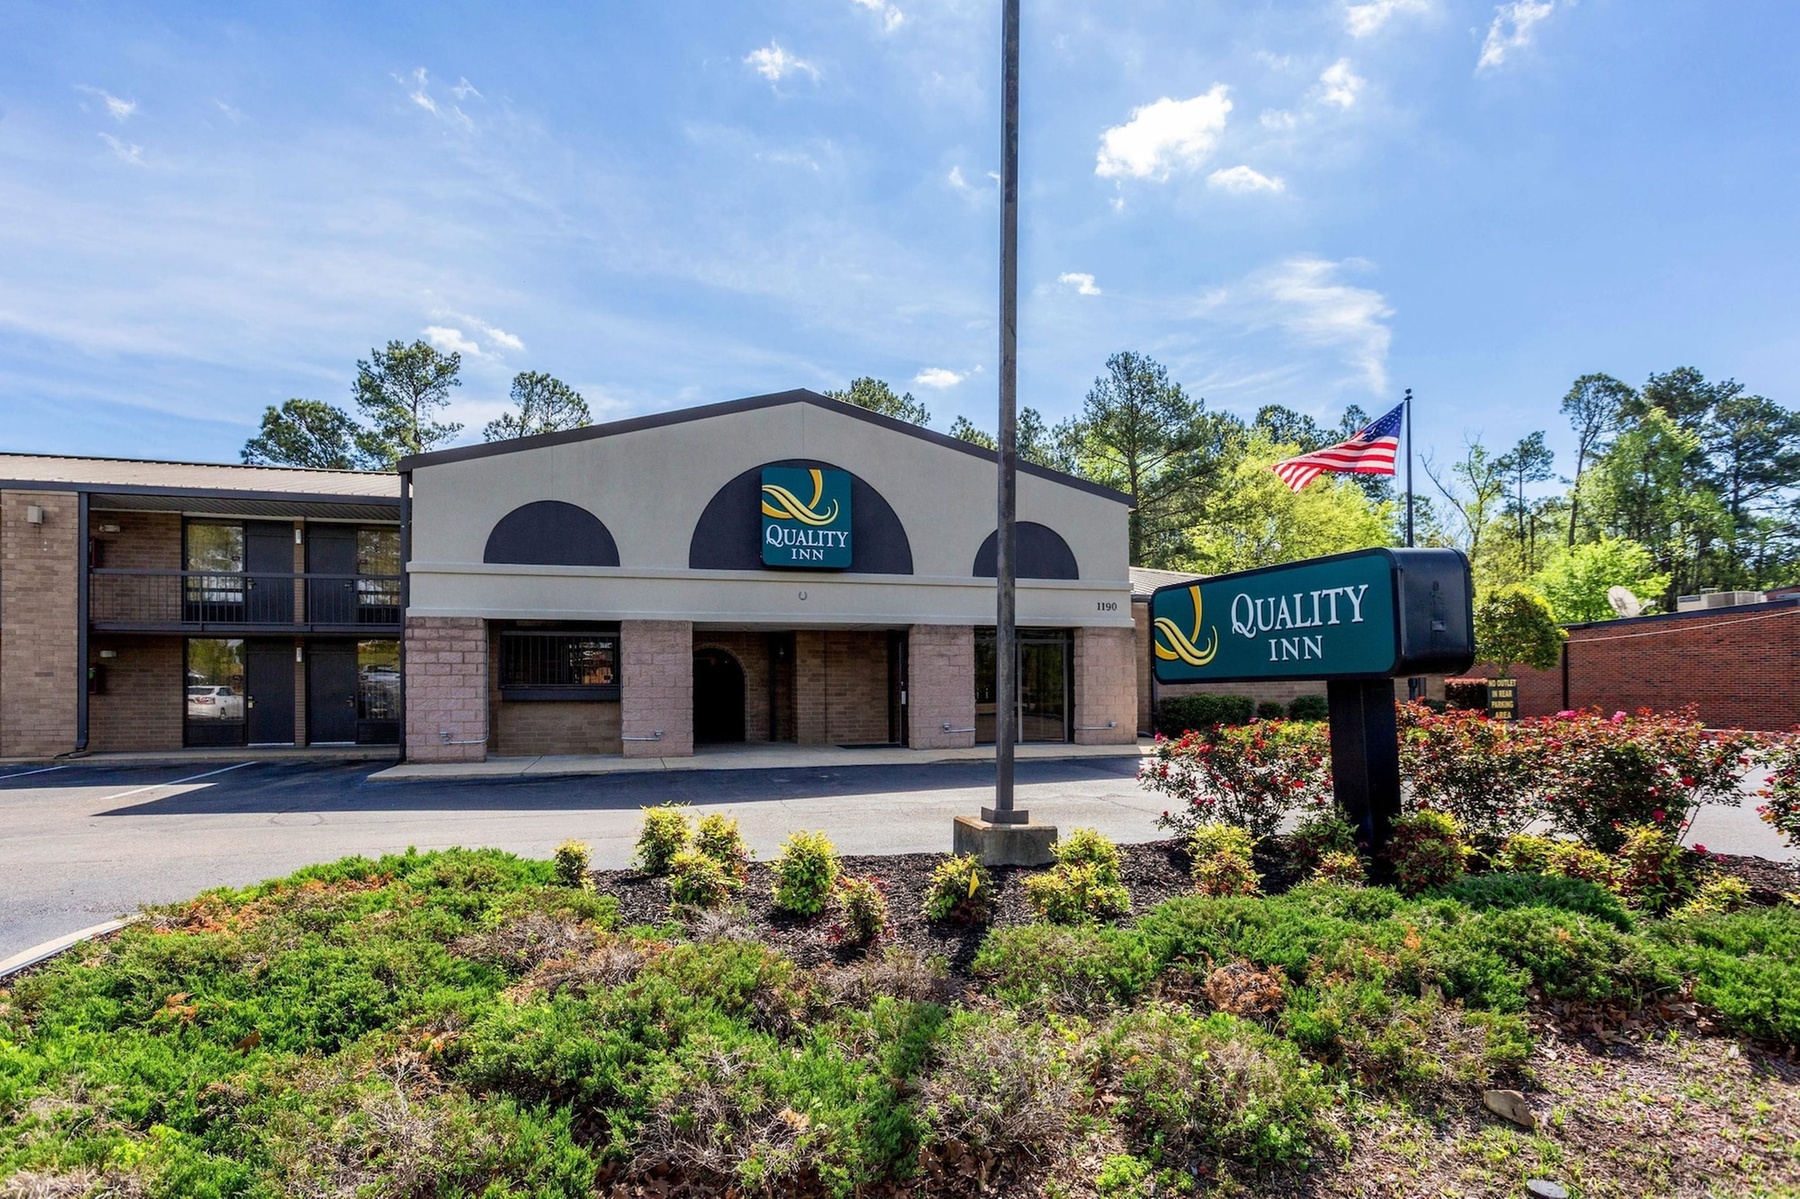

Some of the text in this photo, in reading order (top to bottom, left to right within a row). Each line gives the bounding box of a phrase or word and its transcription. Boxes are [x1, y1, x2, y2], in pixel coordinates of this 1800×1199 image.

[766, 524, 848, 547] QUALITY
[791, 548, 824, 560] INN
[1097, 602, 1117, 611] 1190
[1231, 584, 1369, 638] QUALITY
[1269, 635, 1323, 662] INN
[1497, 679, 1516, 687] OUTLET
